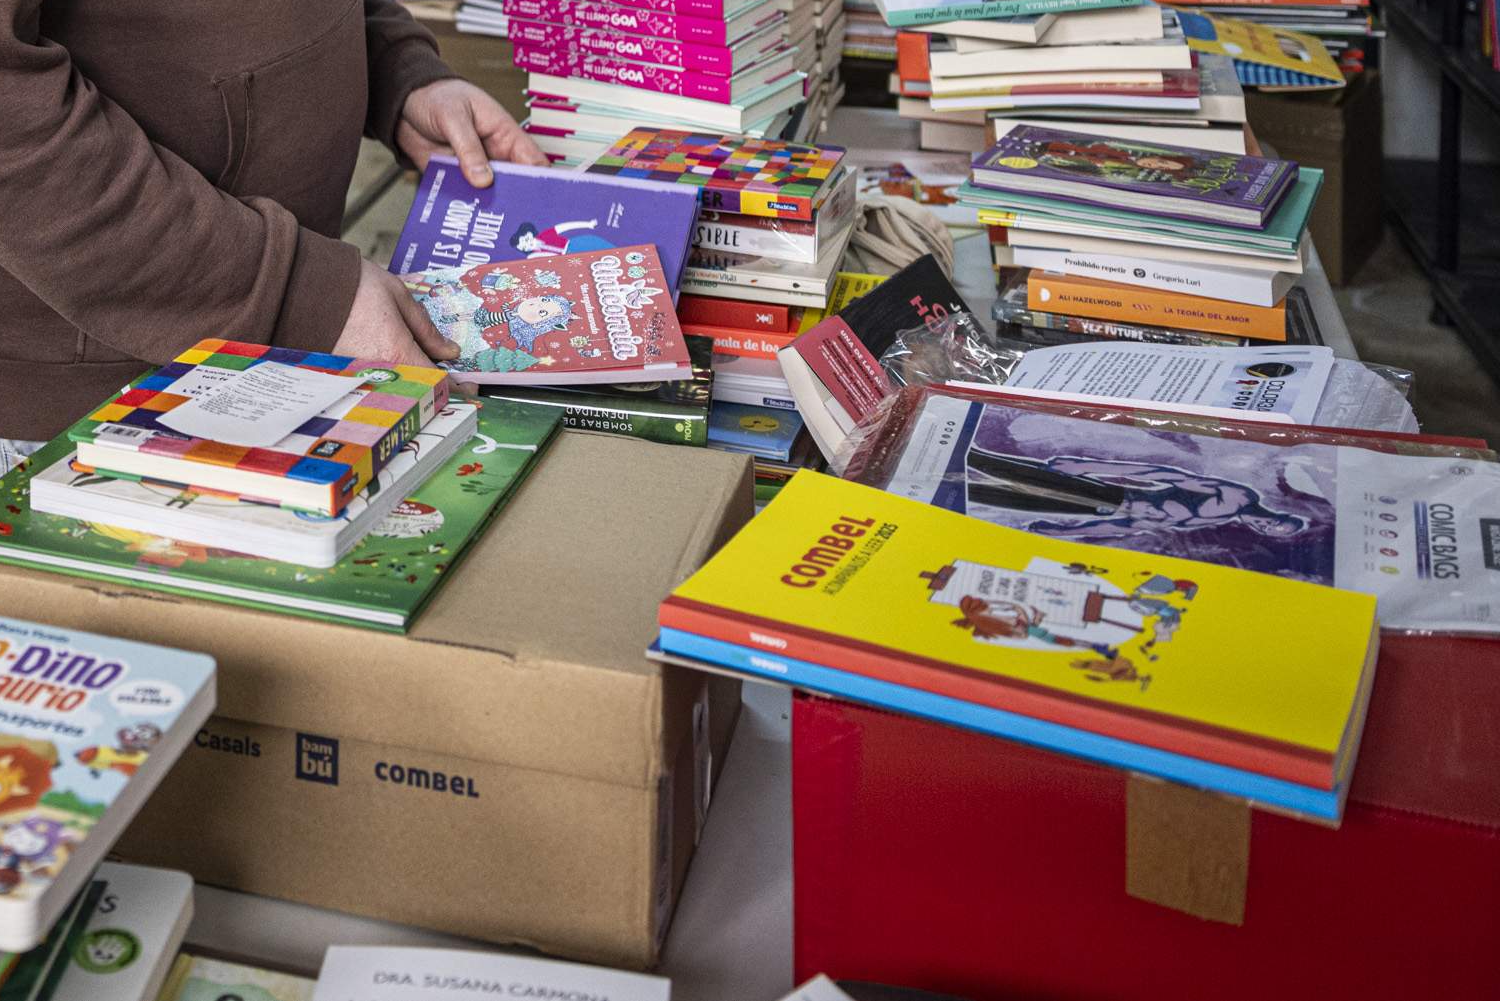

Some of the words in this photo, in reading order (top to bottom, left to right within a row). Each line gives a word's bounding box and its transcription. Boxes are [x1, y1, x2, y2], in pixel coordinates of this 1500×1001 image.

[611, 12, 637, 28] GOA
[616, 41, 643, 55] GOA
[618, 68, 644, 83] GOA
[442, 199, 480, 240] AMOR,
[469, 210, 504, 248] DUELE
[433, 242, 461, 259] ES
[1065, 258, 1100, 271] Prohibido
[1101, 262, 1126, 275] repetir
[1153, 272, 1184, 284] Gregorio
[1185, 278, 1201, 287] Luri
[592, 255, 643, 360] Unicornia
[1059, 294, 1072, 302] ALI
[1073, 295, 1122, 308] HAZELWOOD
[1164, 307, 1175, 315] LA
[1176, 308, 1205, 318] TEORÍA
[1207, 312, 1223, 320] DEL
[1225, 315, 1250, 323] AMOR
[743, 339, 758, 351] de
[841, 330, 854, 348] UNA
[854, 349, 863, 360] DE
[563, 417, 576, 426] DE
[566, 407, 629, 420] IDENTIDAD
[581, 419, 632, 431] SOMBRAS
[1430, 503, 1456, 543] COMIC
[1432, 544, 1460, 579] BAGS
[194, 730, 261, 758] Casals
[302, 738, 332, 754] bam
[302, 756, 332, 778] bú
[423, 974, 503, 993] SUSANA
